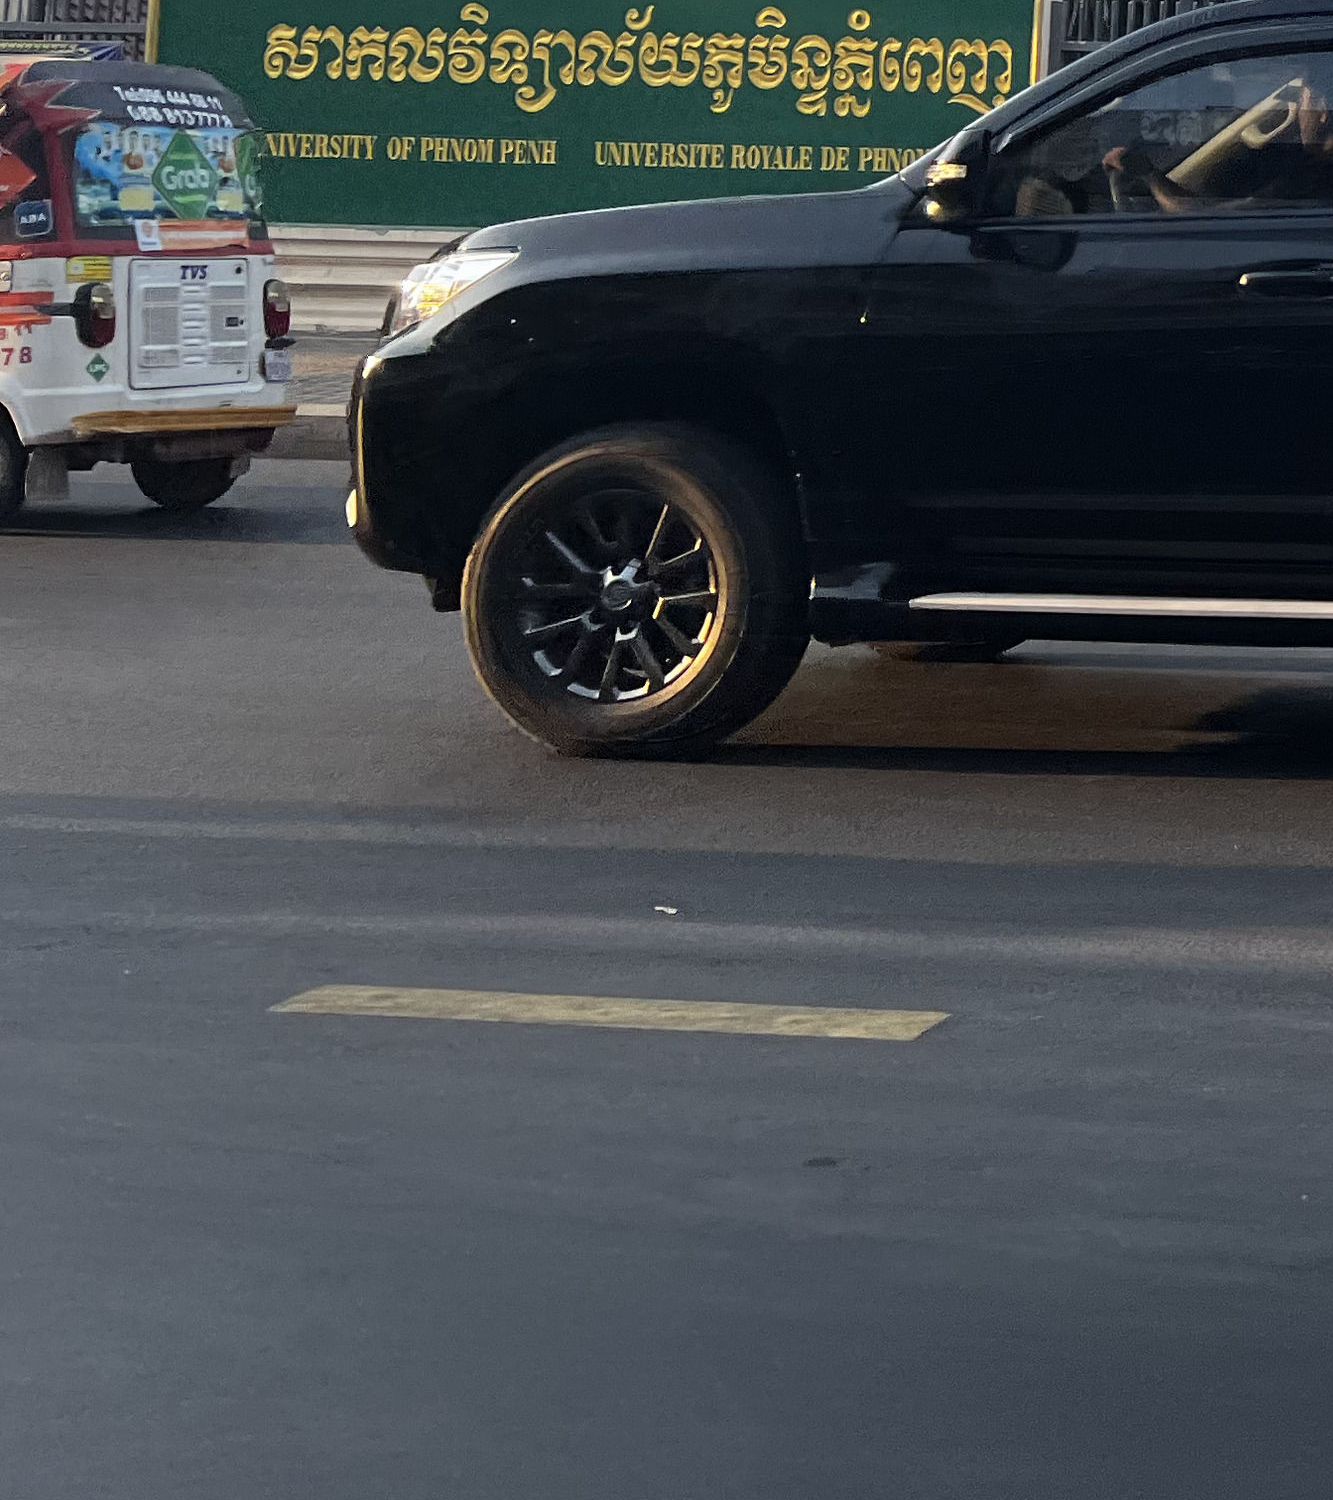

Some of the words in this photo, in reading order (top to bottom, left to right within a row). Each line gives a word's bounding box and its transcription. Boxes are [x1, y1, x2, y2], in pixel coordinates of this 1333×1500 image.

[263, 2, 1013, 118] សាកលវិទ្យាល័យភូមិន្ទភ្នំពេញ
[262, 133, 378, 160] NIVERSITY
[387, 136, 415, 161] OF
[420, 137, 494, 164] PHNOM
[498, 139, 557, 165] PENH
[594, 141, 724, 169] UNIVERSITE
[730, 145, 812, 171] ROYALE
[820, 146, 850, 172] DE
[160, 161, 210, 190] Grab
[19, 211, 46, 225] ABA
[180, 265, 208, 280] TVS
